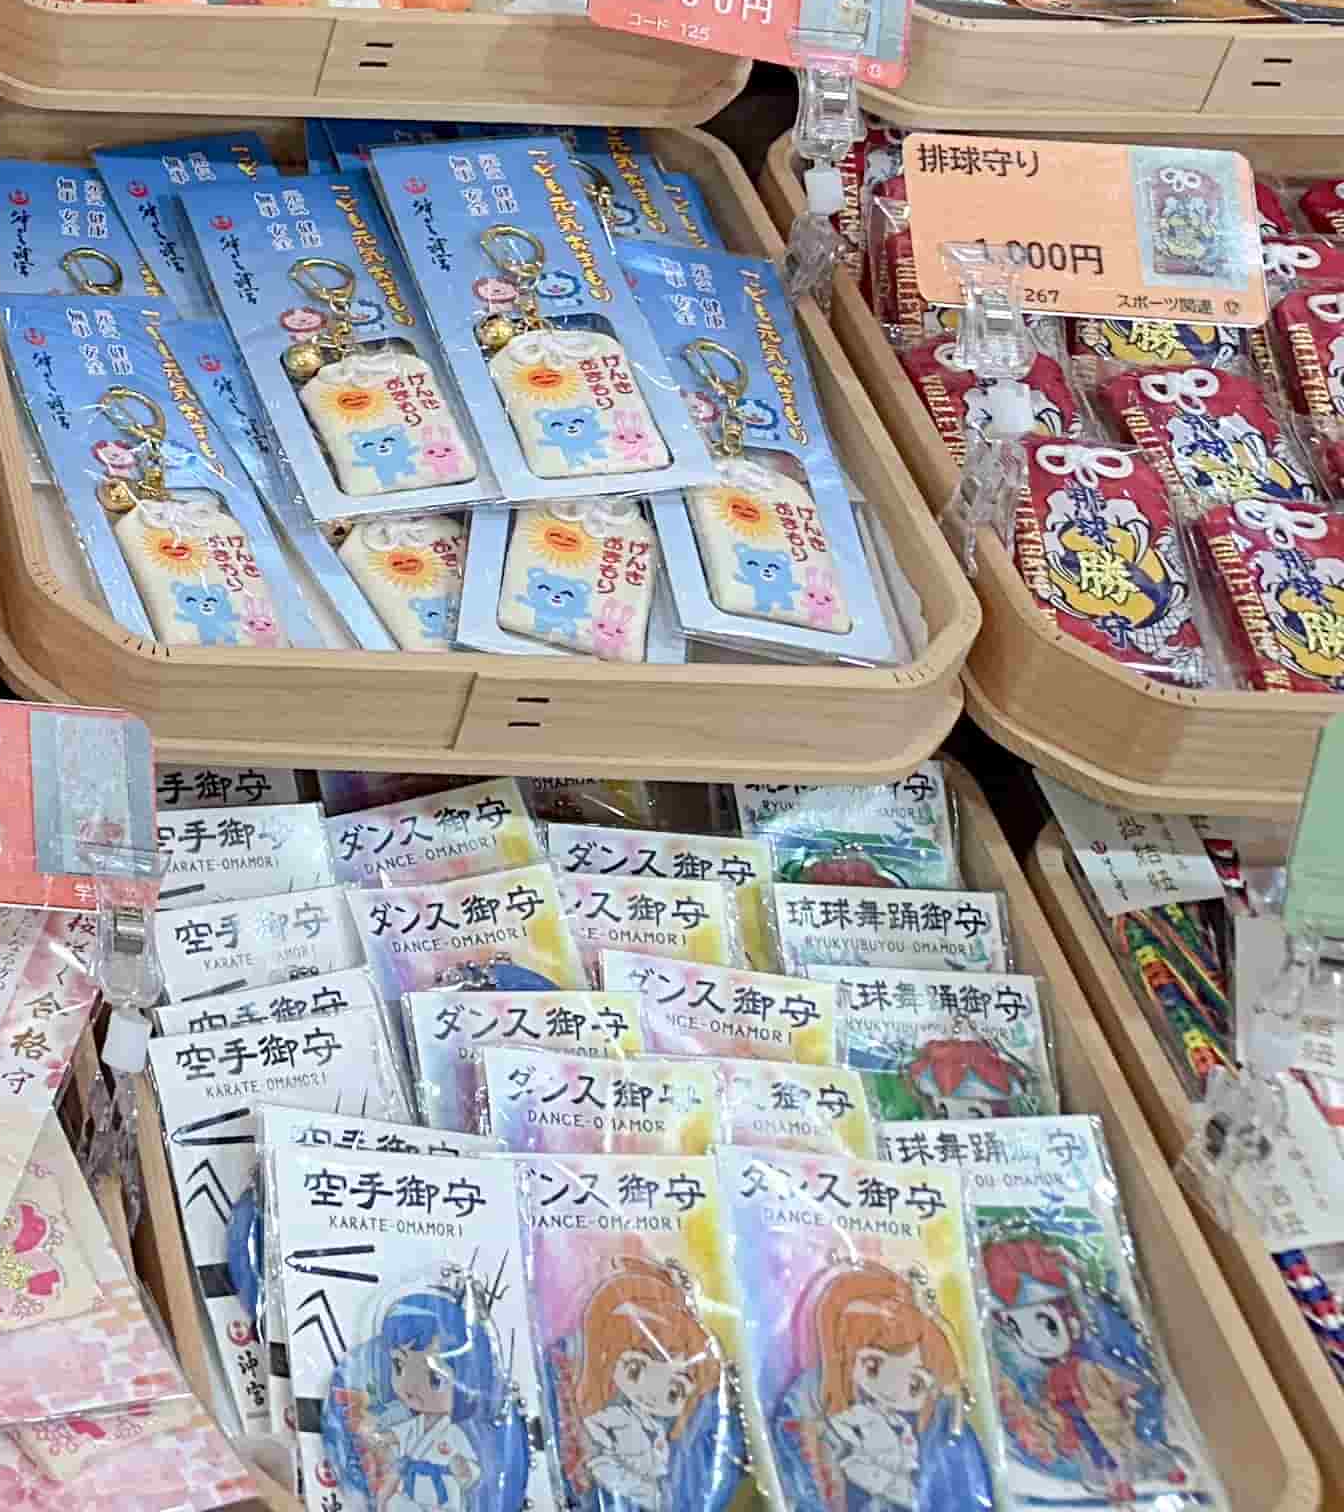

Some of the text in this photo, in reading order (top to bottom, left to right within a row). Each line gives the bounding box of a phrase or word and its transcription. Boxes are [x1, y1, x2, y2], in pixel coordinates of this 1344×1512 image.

[627, 12, 712, 41] コード 125
[918, 144, 1041, 177] 排球守り
[1117, 294, 1215, 315] スポーツ関連
[406, 371, 441, 411] げんき
[578, 359, 615, 411] おまもり
[601, 354, 634, 396] げんき
[776, 502, 810, 563] おまもり
[795, 506, 827, 554] げんき
[626, 540, 650, 587] げんき
[338, 796, 512, 861] ダンス御守
[565, 842, 758, 887] ダンス御守
[370, 885, 545, 938] ダンス御守
[785, 899, 991, 940] 琉球舞踊御守
[392, 925, 529, 953] DANCE-OMAMORI
[434, 1002, 630, 1041] ダンス御守
[175, 1027, 343, 1081] 空手御守
[205, 1072, 329, 1099] KARATE-OMAMORI
[302, 1169, 488, 1219] 空手御守
[327, 1214, 465, 1239] KARATE-OMAMORI
